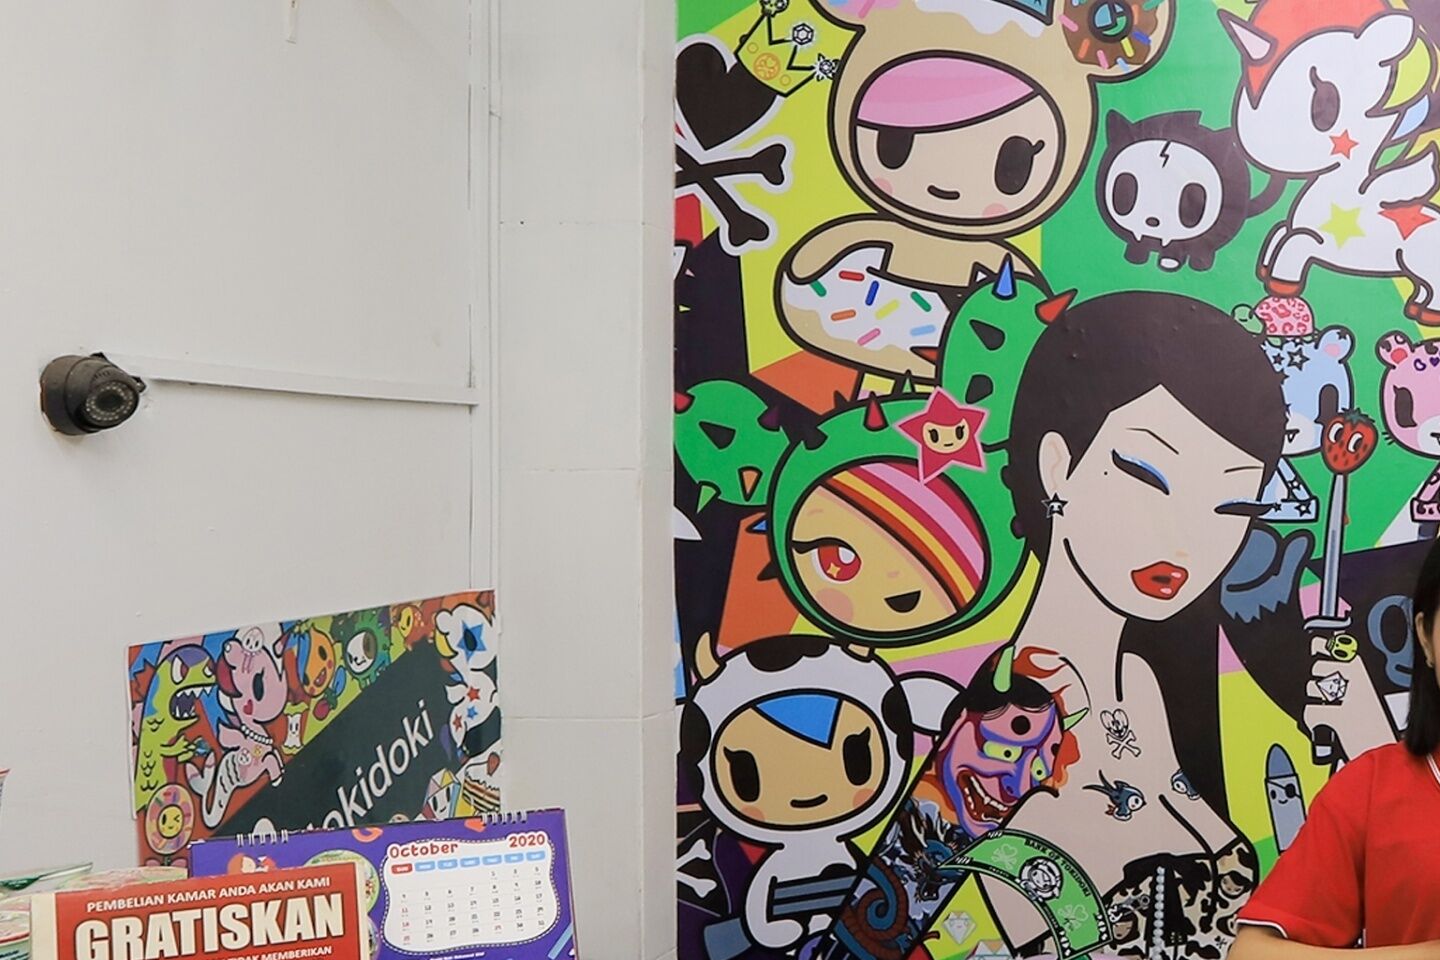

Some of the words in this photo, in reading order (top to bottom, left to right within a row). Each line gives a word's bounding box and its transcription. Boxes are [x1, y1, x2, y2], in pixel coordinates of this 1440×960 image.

[304, 699, 434, 832] okidoki
[389, 842, 458, 859] October
[509, 833, 545, 848] 2020
[1024, 838, 1047, 854] BANK
[1049, 850, 1061, 862] OF
[1060, 858, 1092, 898] TOKIDOKI
[87, 894, 164, 912] PEMBELIAN
[167, 889, 216, 904] KAMAR
[218, 885, 256, 898] ANDA
[258, 881, 294, 893] AKAN
[296, 876, 330, 889] KAMI
